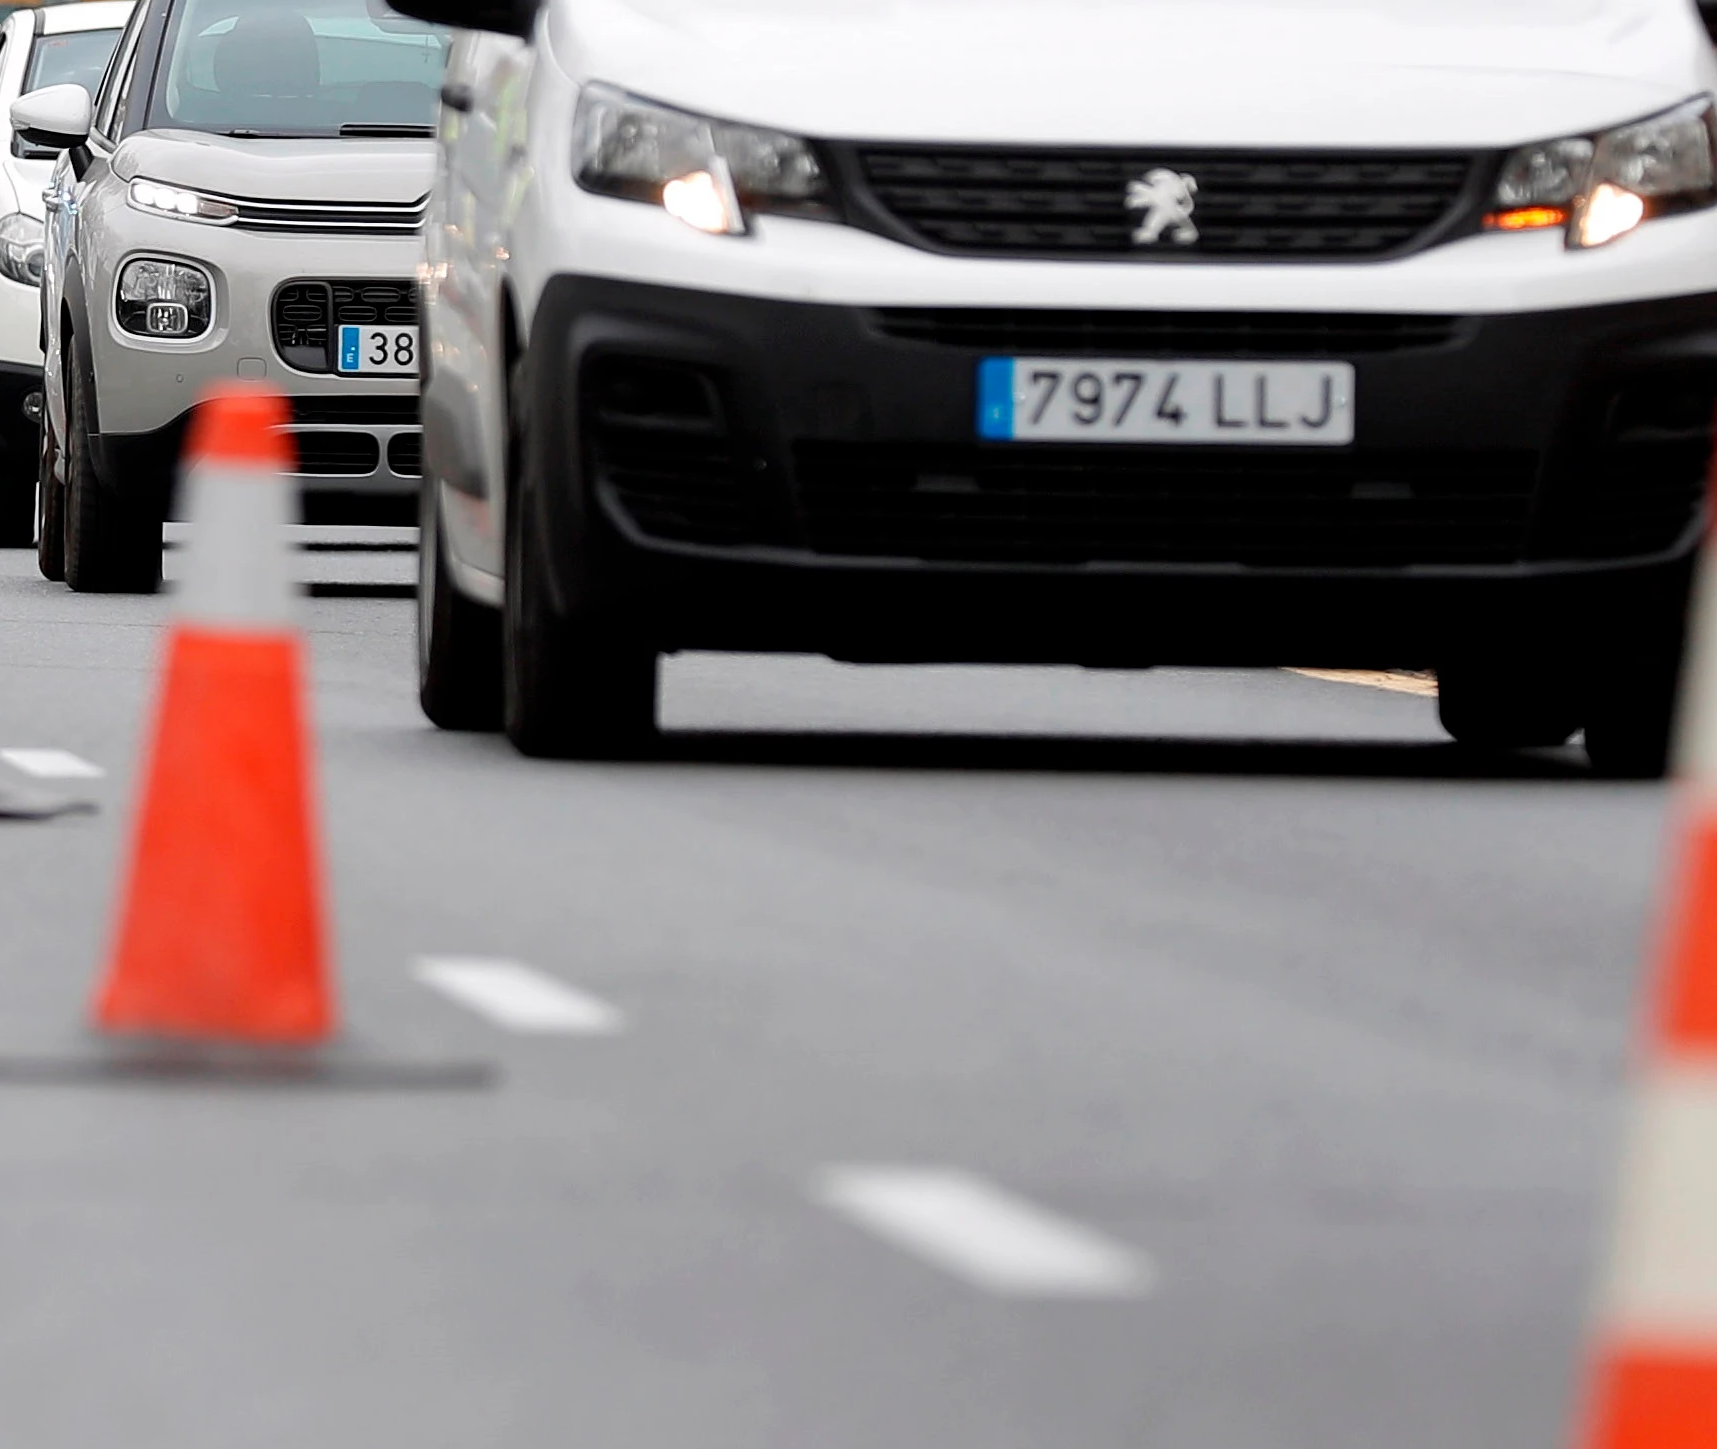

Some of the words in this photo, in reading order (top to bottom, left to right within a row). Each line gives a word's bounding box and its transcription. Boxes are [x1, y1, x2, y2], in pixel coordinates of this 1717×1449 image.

[368, 332, 414, 366] 38
[1031, 371, 1188, 426] 7974
[1214, 373, 1332, 429] LLJ
